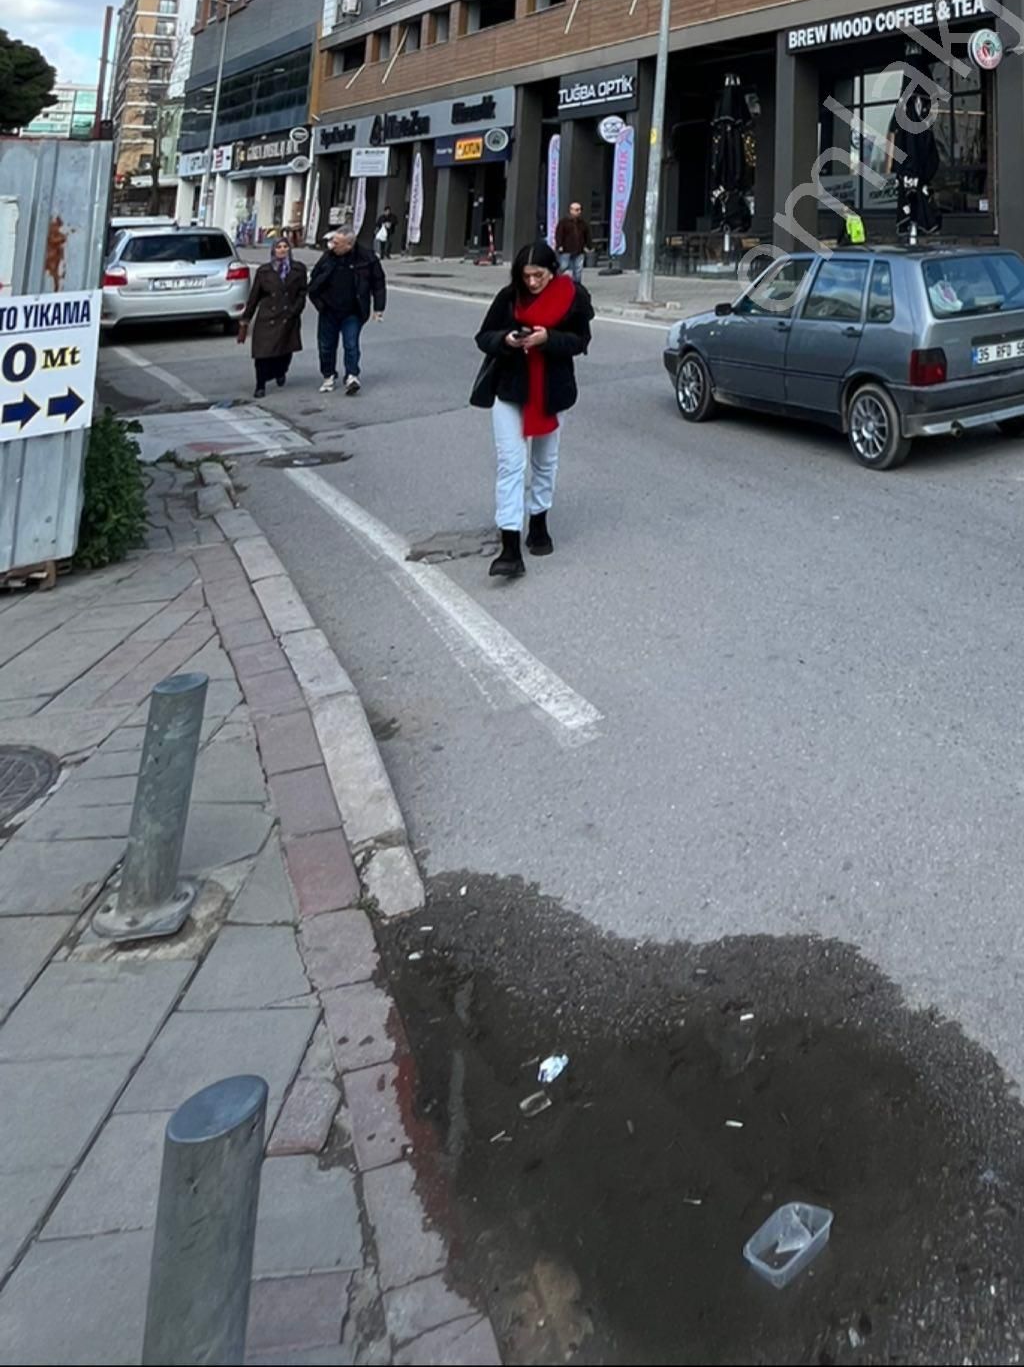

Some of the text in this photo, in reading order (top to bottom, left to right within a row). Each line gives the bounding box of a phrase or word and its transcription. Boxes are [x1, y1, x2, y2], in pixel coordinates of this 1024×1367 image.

[788, 24, 828, 49] BREW
[830, 15, 872, 41] MOOD
[875, 4, 933, 33] COFFEE
[558, 74, 634, 104] TUĞBA OPTİK
[23, 299, 91, 329] YIKAMA
[41, 346, 81, 370] Mt
